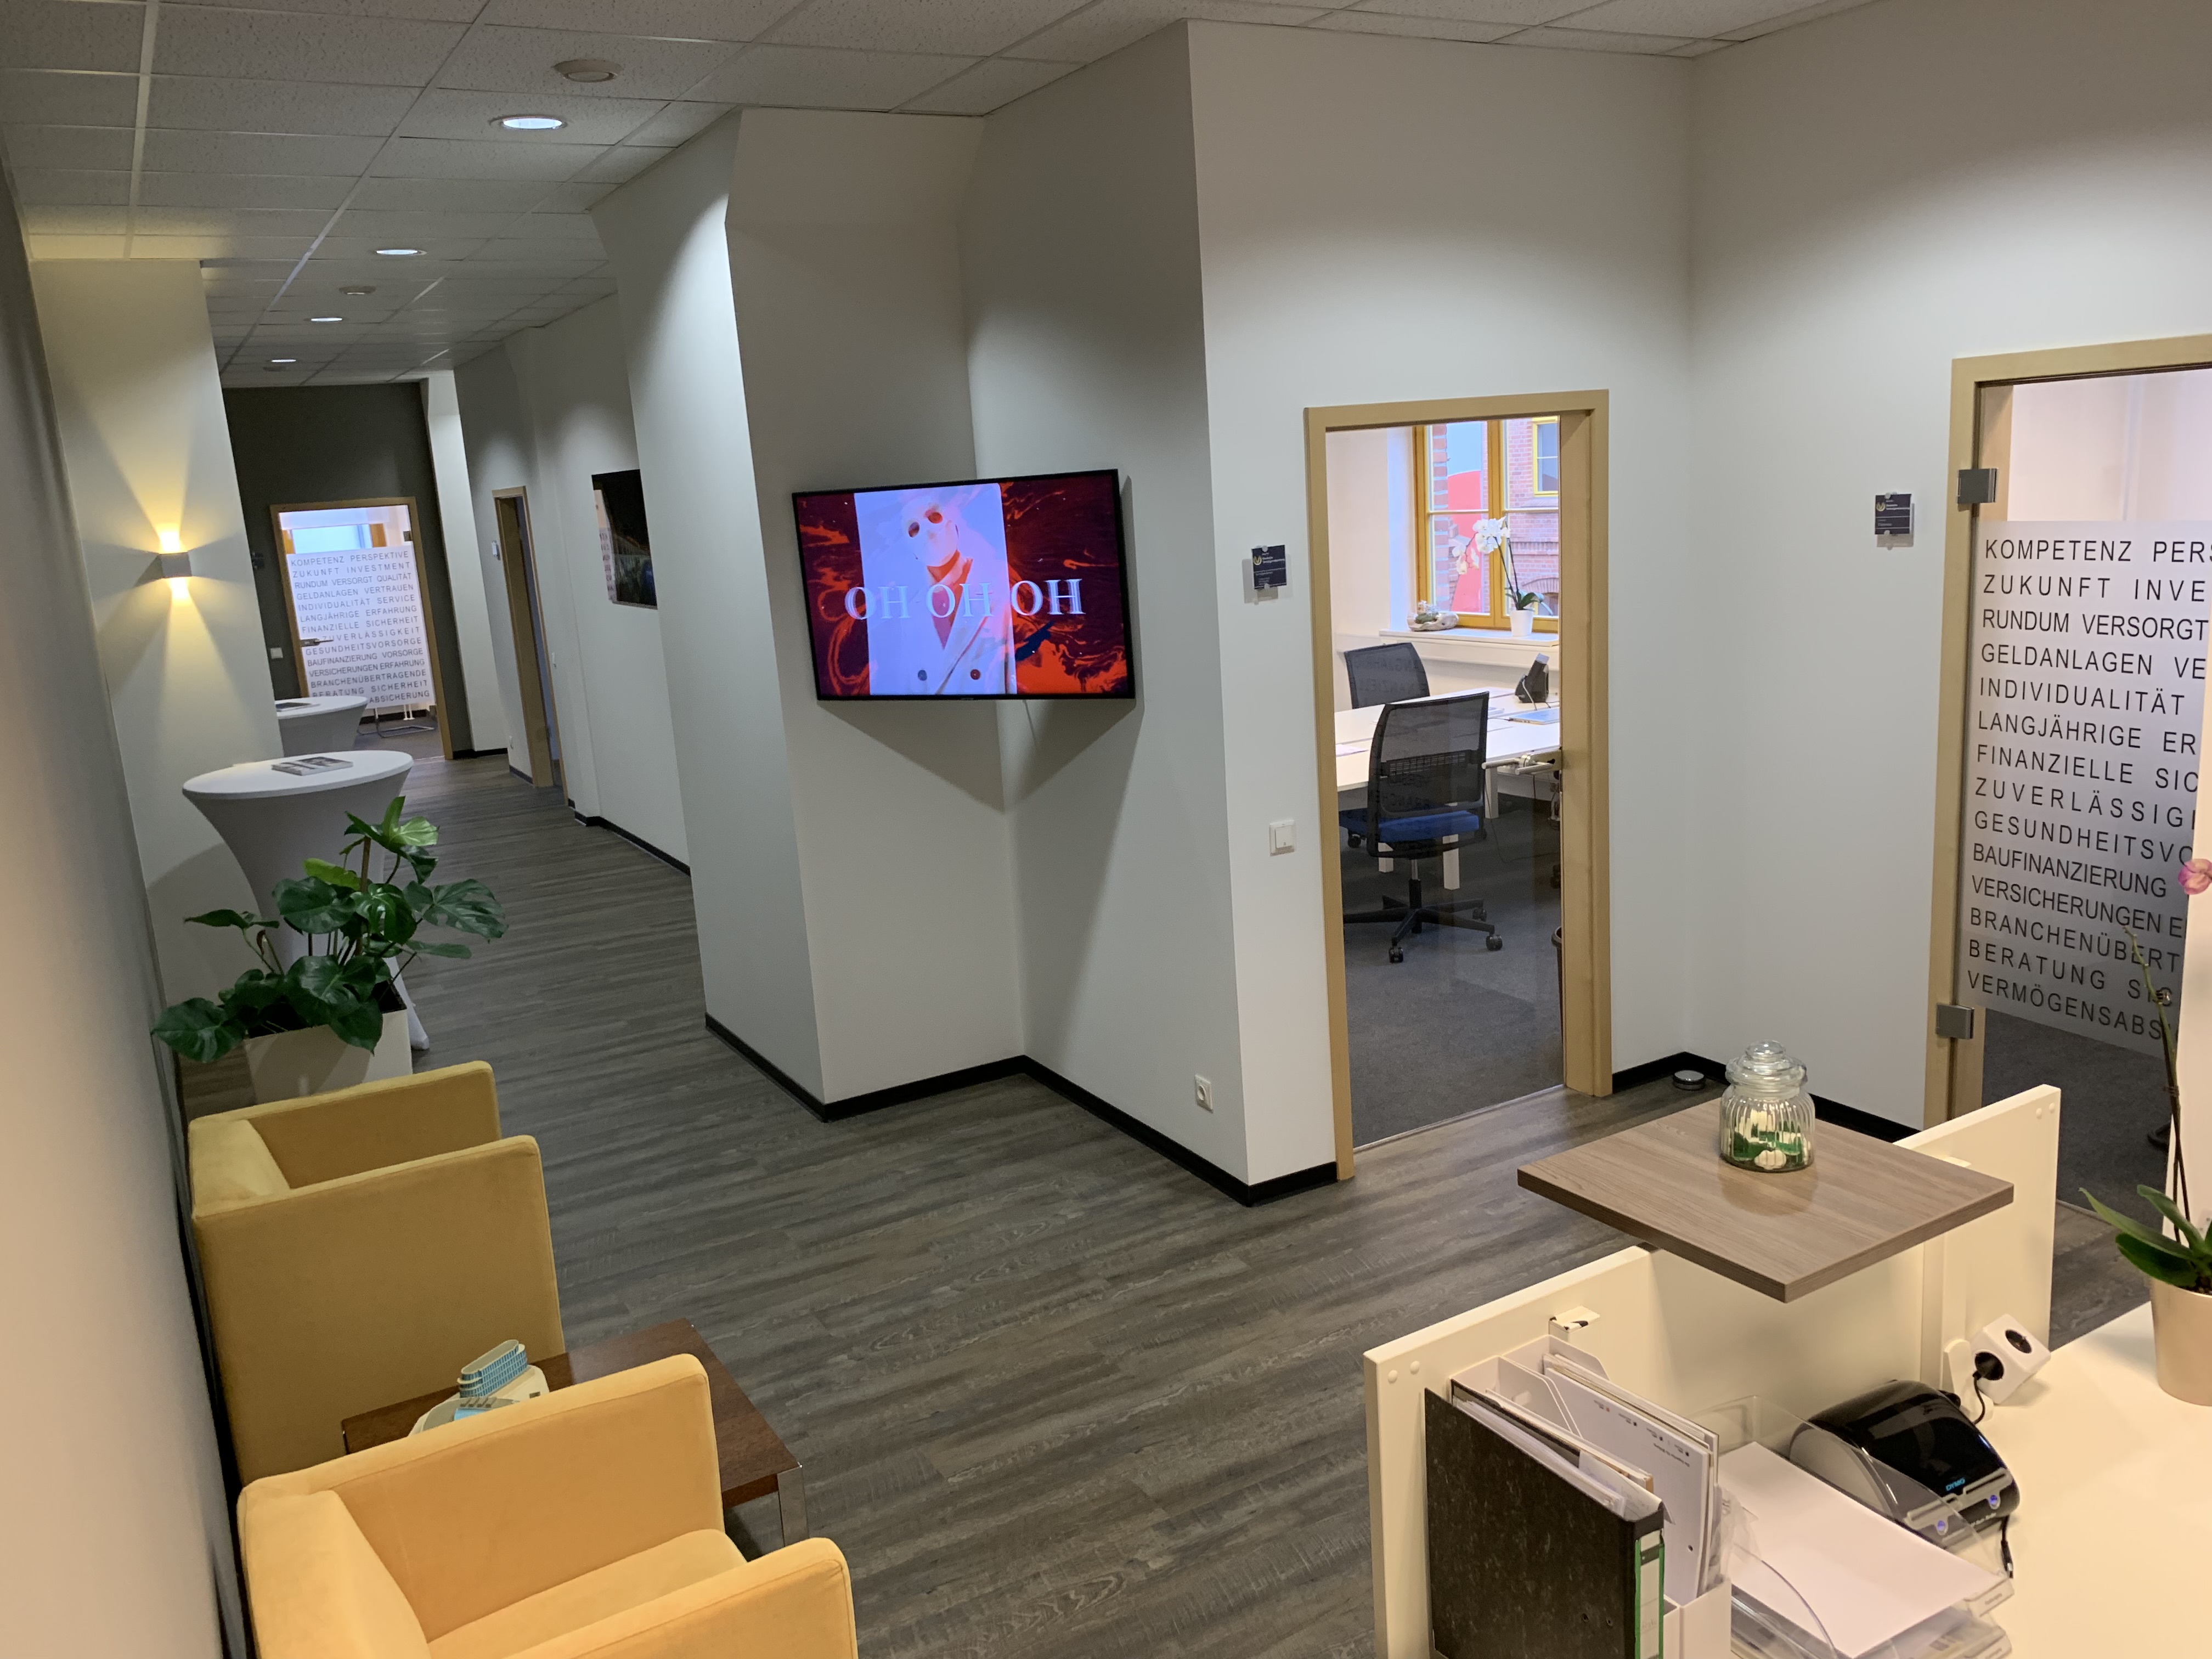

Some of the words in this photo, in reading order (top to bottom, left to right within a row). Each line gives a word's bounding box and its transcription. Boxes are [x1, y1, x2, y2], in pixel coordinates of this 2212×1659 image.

[291, 556, 345, 566] KOMPETENZ
[351, 551, 409, 562] PERSPEKTIVE
[1985, 539, 2132, 562] KOMPETENZ
[292, 567, 340, 578] ZUKUNFT
[347, 562, 410, 573] INVESTMENT
[295, 579, 328, 589] RUNDUM
[332, 577, 373, 586] VERSORGT
[297, 589, 358, 600] GELDANLAGEN
[364, 584, 414, 594] VERTRAUEN
[1983, 574, 2111, 598] ZUKUNFT
[2135, 579, 2205, 602] INVE
[298, 597, 371, 611] INDIVIDUALITÄT
[377, 594, 415, 605] SERVICE
[844, 585, 910, 620] OH
[925, 582, 995, 618] OH
[1010, 578, 1086, 616] OH
[300, 610, 360, 622] LANGJÄHRIGE
[366, 605, 417, 617] ERFAHRUNG
[302, 622, 359, 634] FINANZIELLE
[366, 616, 418, 627] SICHERHEIT
[1982, 609, 2069, 633] RUNDUM
[2083, 614, 2209, 641] VERSORGT
[306, 637, 421, 656] GESUNDHEITSVORSORGE
[322, 627, 420, 641] ZUVERLÄSSIGKEIT
[307, 652, 377, 667] BAUFINANZIERUNG
[382, 648, 423, 658] VORSORGE
[309, 663, 378, 677] VERSICHERUNGEN
[380, 658, 425, 669] ERFAHRUNG
[1982, 644, 2152, 675] GELDANLAGEN
[2174, 657, 2206, 680] VE
[311, 669, 426, 688] BRANCHENÜBERTRAGENDE
[371, 680, 427, 693] SICHERHEIT
[1980, 677, 2185, 715] INDIVIDUALITÄT
[1978, 710, 2141, 748] LANGJÄHRIGE
[2163, 731, 2196, 755] ER
[1977, 744, 2133, 783] FINANZIELLE
[2155, 768, 2198, 792] SIC
[1975, 777, 2196, 830] ZUVERLÄSSIG
[1974, 811, 2193, 866] GESUNDHEITSVO
[1973, 843, 2166, 898] BAUFINANZIERUNG
[1972, 875, 2161, 934] VERSICHERUNGEN
[2169, 917, 2186, 939] E
[1970, 907, 2180, 973] BRANCHENÜBERT
[1969, 940, 2105, 990] BERATUNG
[1967, 970, 2171, 1040] VERMÖGENSABS
